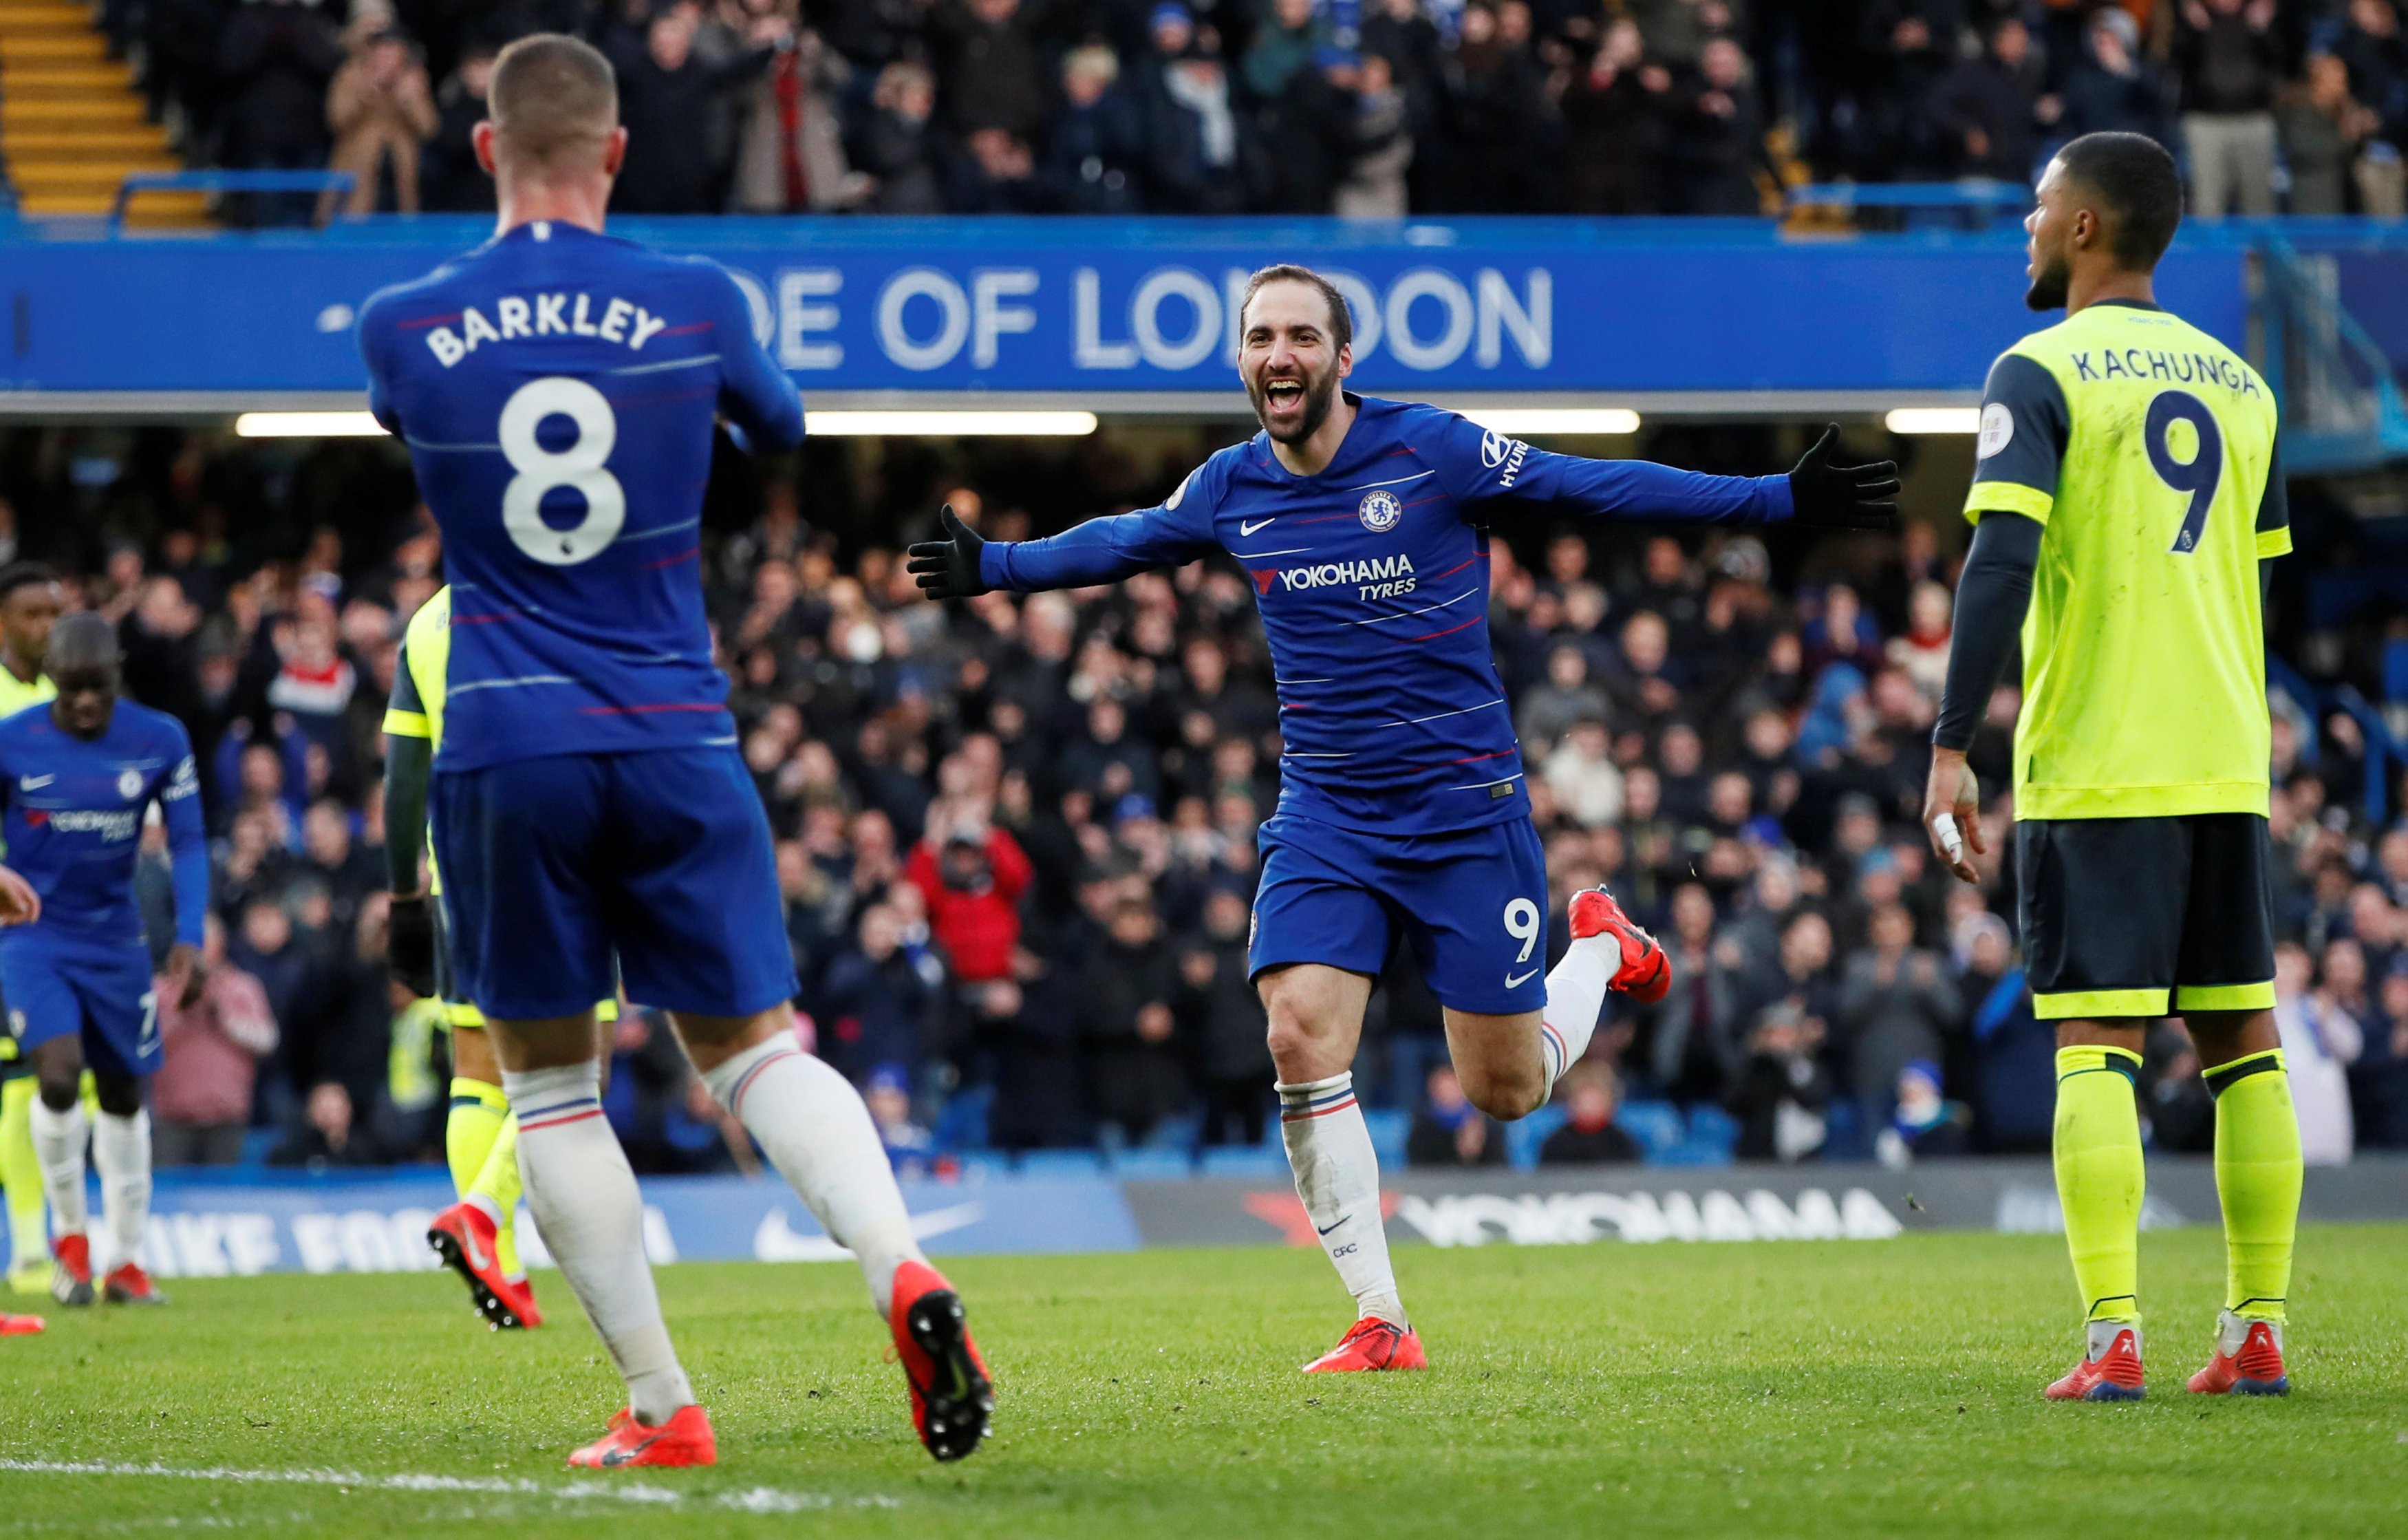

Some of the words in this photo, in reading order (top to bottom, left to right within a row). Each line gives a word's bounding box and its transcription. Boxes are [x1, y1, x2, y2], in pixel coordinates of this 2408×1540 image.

[426, 292, 665, 369] BARKLEY
[874, 266, 1040, 372] OF
[1071, 266, 1553, 372] LODON
[2070, 348, 2261, 400] KACHUNGA
[498, 376, 626, 566] 8
[1364, 492, 1391, 504] CHELSEA
[2144, 389, 2223, 554] 9
[1278, 553, 1415, 592] YOKOHAMA
[1358, 577, 1416, 601] TYRES
[1503, 897, 1540, 963] 9
[1333, 1243, 1357, 1258] CFC
